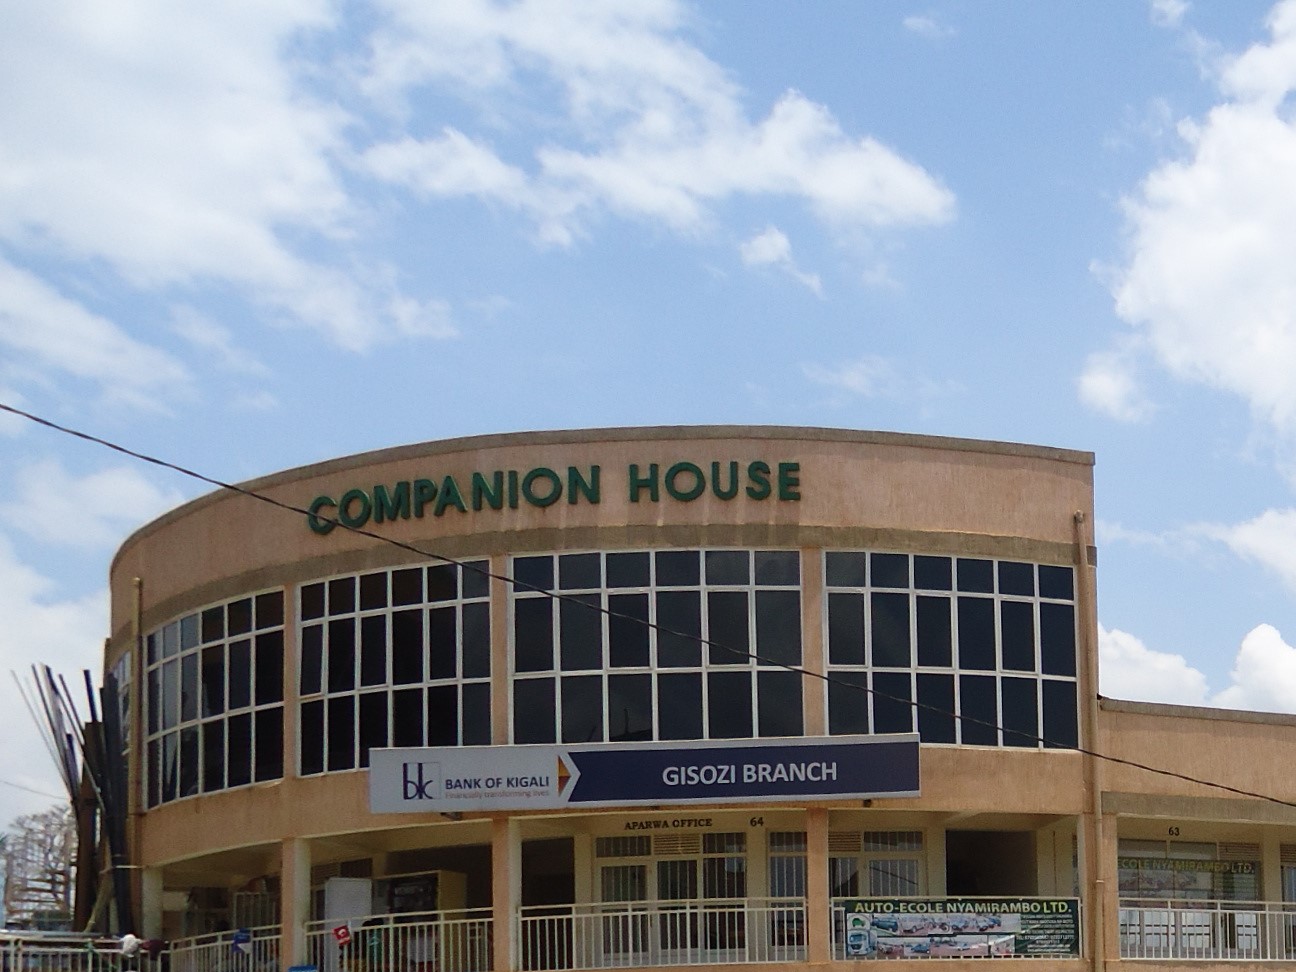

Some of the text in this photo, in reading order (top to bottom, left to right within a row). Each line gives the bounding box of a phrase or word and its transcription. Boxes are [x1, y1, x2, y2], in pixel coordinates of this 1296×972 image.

[308, 461, 801, 535] COMPANION HOUSE
[662, 762, 837, 786] GISOZI BRANCH
[445, 776, 550, 790] BANK OF KIGALI
[624, 818, 713, 830] APARWA OFFICE
[750, 817, 764, 827] 64
[1168, 827, 1180, 836] 63
[1231, 862, 1255, 873] LTD.
[855, 902, 1072, 913] AUTO-ECOLE NYAMIRAMBO LTD.
